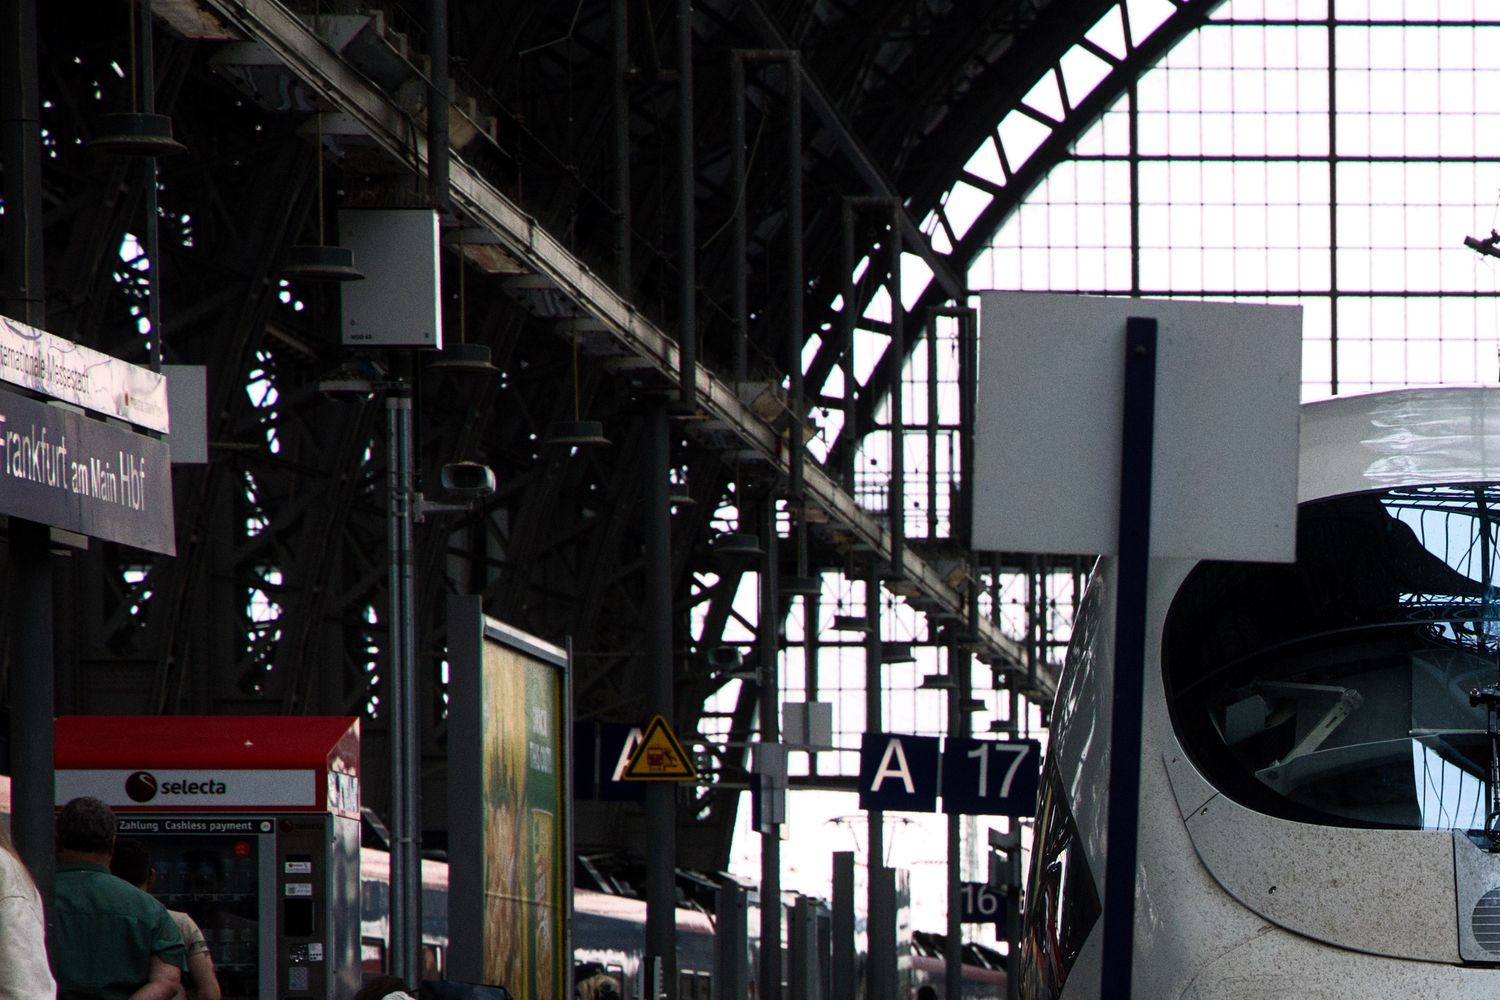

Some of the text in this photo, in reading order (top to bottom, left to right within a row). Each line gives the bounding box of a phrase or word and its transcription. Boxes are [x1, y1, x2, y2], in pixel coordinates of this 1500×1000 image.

[47, 352, 90, 394] Messestadt
[72, 461, 89, 495] am
[90, 457, 117, 503] Main
[120, 451, 145, 511] Hbf
[870, 738, 916, 793] A
[967, 743, 1030, 798] 17
[161, 780, 226, 795] selecta
[119, 820, 252, 832] Zahlung Cashless payment
[961, 884, 998, 915] 16
